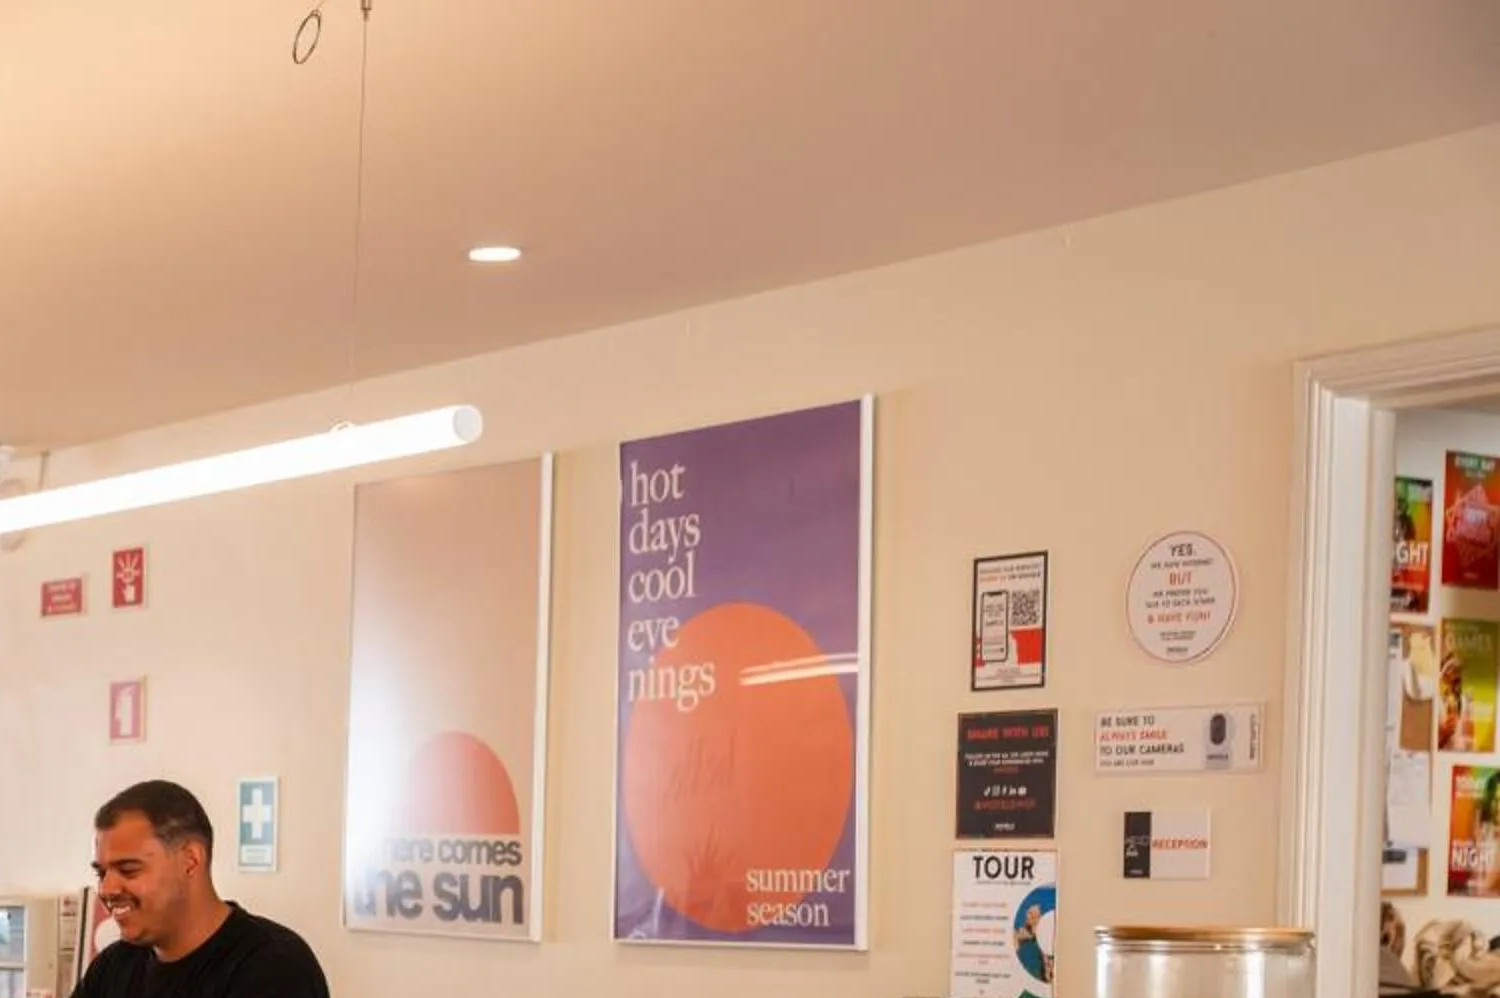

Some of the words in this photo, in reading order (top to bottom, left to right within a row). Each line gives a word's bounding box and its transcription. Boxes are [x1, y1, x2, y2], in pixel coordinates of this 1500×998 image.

[631, 461, 686, 507] hot
[629, 507, 700, 564] days
[1395, 541, 1429, 566] GHT
[628, 551, 697, 604] cool
[628, 616, 680, 652] eve
[628, 655, 716, 713] nings
[438, 839, 523, 866] comes
[973, 855, 1035, 880] TOUR
[433, 871, 525, 925] sun
[745, 868, 851, 893] summer
[746, 902, 830, 927] season
